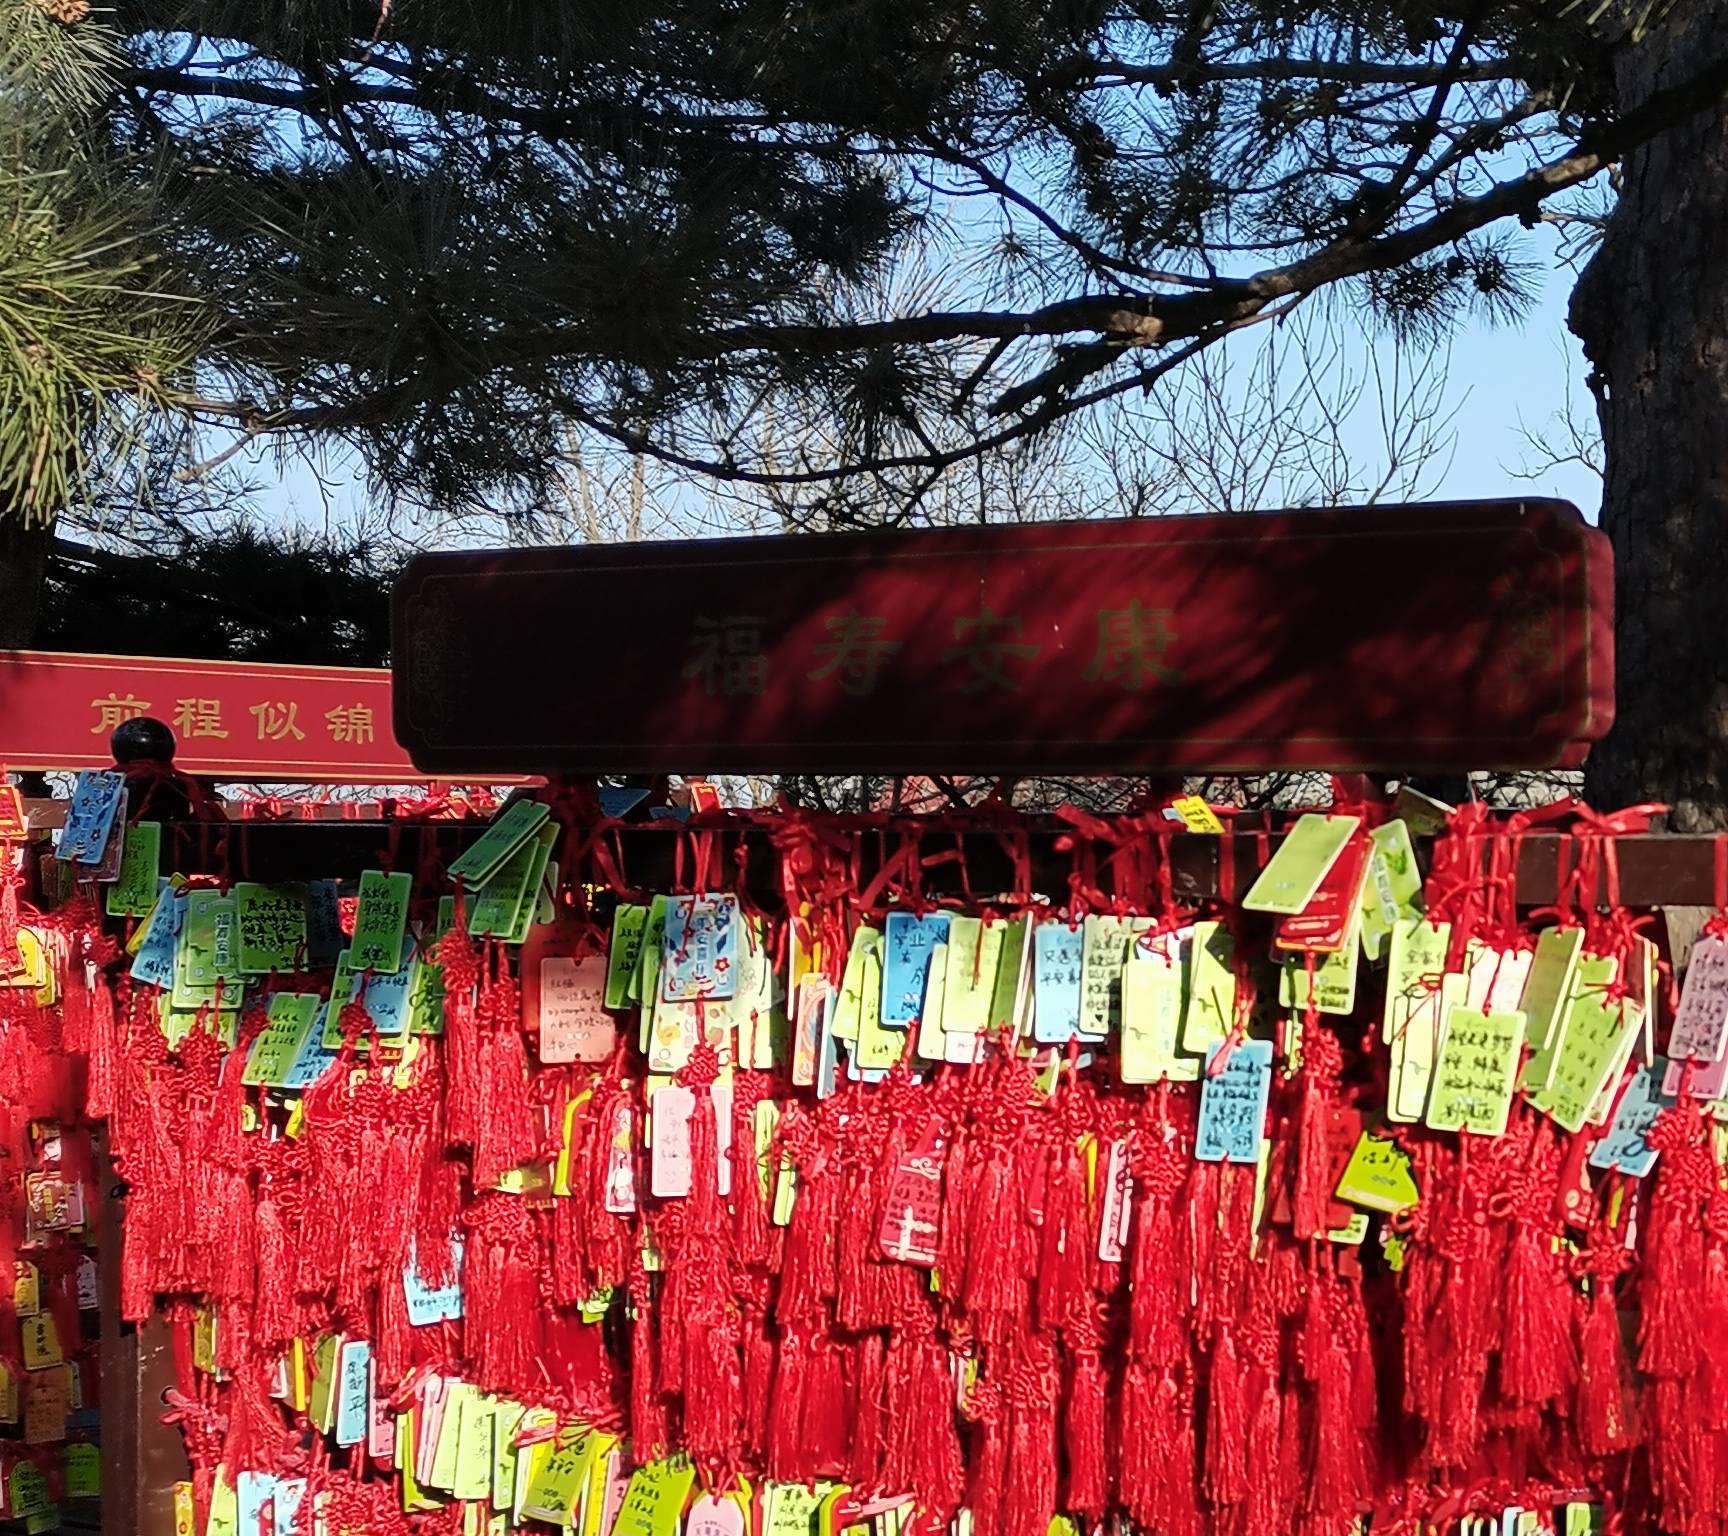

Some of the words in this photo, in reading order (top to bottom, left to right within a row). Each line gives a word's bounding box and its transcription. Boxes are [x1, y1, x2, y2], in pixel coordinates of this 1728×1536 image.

[682, 598, 1184, 697] 福寿安康
[90, 692, 375, 746] 前程似锦
